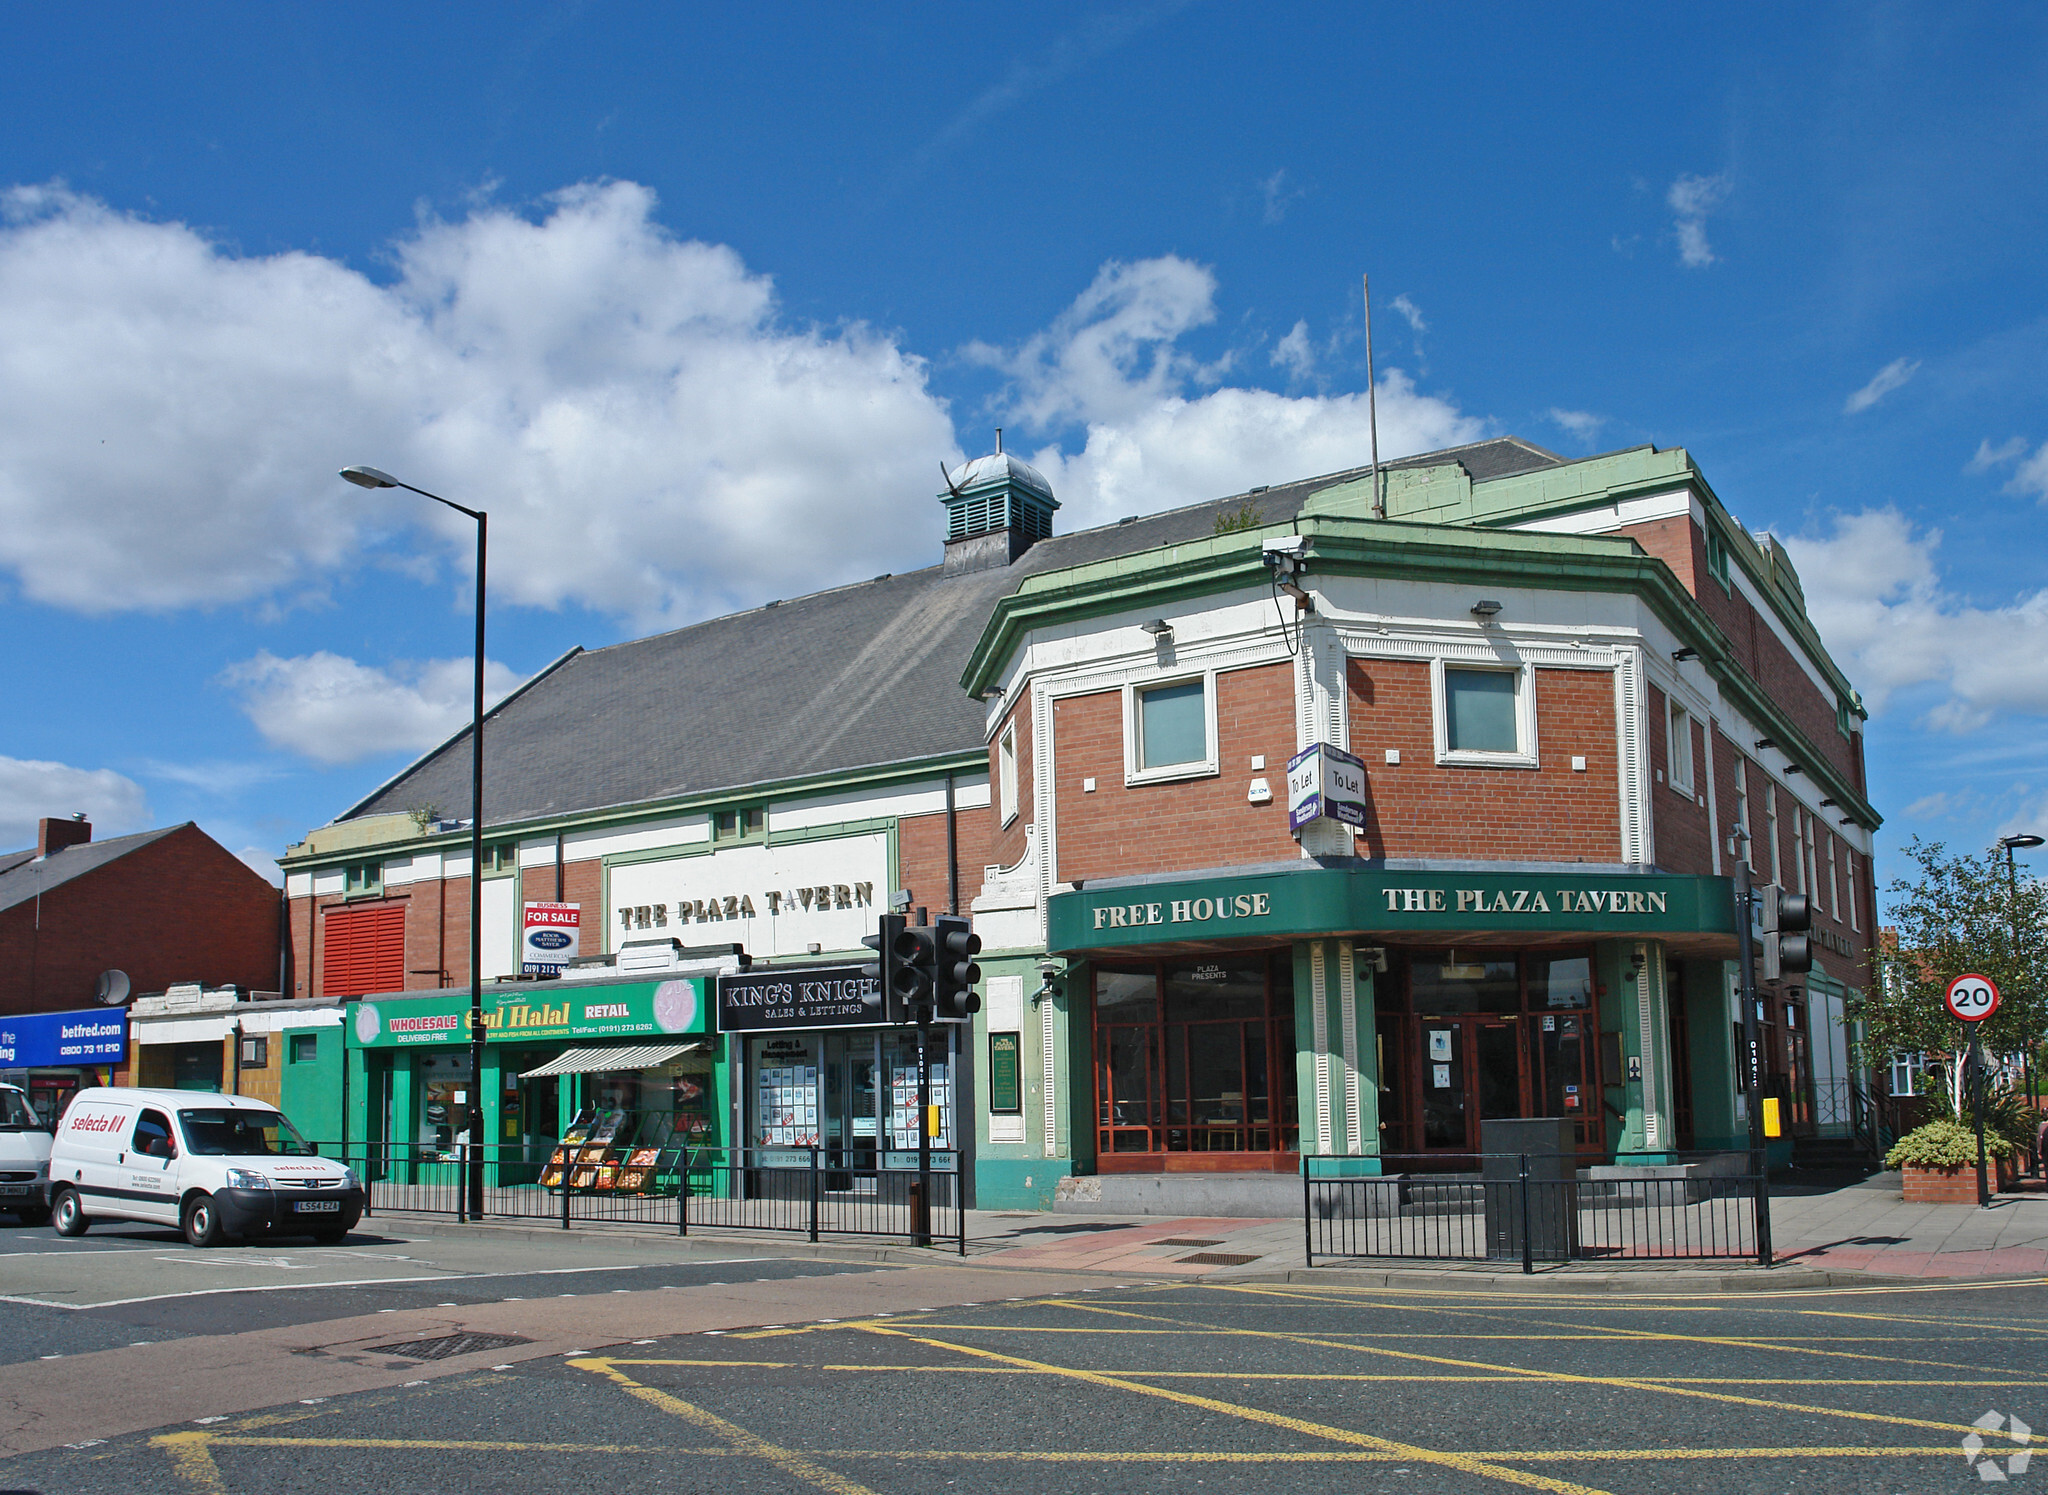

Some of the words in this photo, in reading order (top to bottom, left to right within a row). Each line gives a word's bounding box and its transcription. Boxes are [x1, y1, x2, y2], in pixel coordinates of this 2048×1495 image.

[1292, 778, 1298, 795] To
[1301, 770, 1312, 789] Let
[1333, 770, 1343, 788] To
[1346, 776, 1359, 794] Let
[618, 904, 668, 930] THE
[677, 893, 756, 925] PLAZA
[764, 881, 874, 915] TAVERN
[1382, 888, 1447, 912] THE
[1455, 889, 1551, 914] PLAZA
[1556, 890, 1668, 914] TAVERN
[527, 912, 549, 922] FOR
[551, 913, 578, 923] SALE
[1092, 902, 1164, 930] FREE
[1170, 892, 1271, 924] HOUSE
[524, 964, 539, 973] 0191
[541, 965, 555, 974] 212
[1191, 971, 1227, 980] PRESENTS
[1196, 964, 1219, 972] PLAZA
[726, 982, 793, 1008] KING'S
[799, 978, 880, 1003] KNIGH
[1954, 986, 1990, 1008] 20
[507, 1002, 571, 1028] Halal
[585, 1003, 629, 1020] RETAIL
[765, 1008, 794, 1018] SALES
[798, 1007, 806, 1016] &
[810, 1004, 862, 1016] LETTINGS
[62, 1022, 120, 1038] betfred.com
[389, 1015, 458, 1032] WHOLESALE
[572, 1026, 598, 1034] Tel/Fax:
[598, 1025, 620, 1034] (0191)
[622, 1024, 634, 1032] 273
[2, 1032, 16, 1044] the
[398, 1034, 431, 1042] DELIVERED
[432, 1032, 448, 1042] FREE
[541, 1028, 570, 1036] CONTINENTS
[60, 1046, 82, 1055] 0800
[83, 1045, 94, 1054] 73
[96, 1044, 104, 1053] 11
[104, 1043, 120, 1052] 210
[71, 1114, 108, 1132] selecta
[785, 1154, 797, 1162] 273
[300, 1202, 321, 1210] LS54
